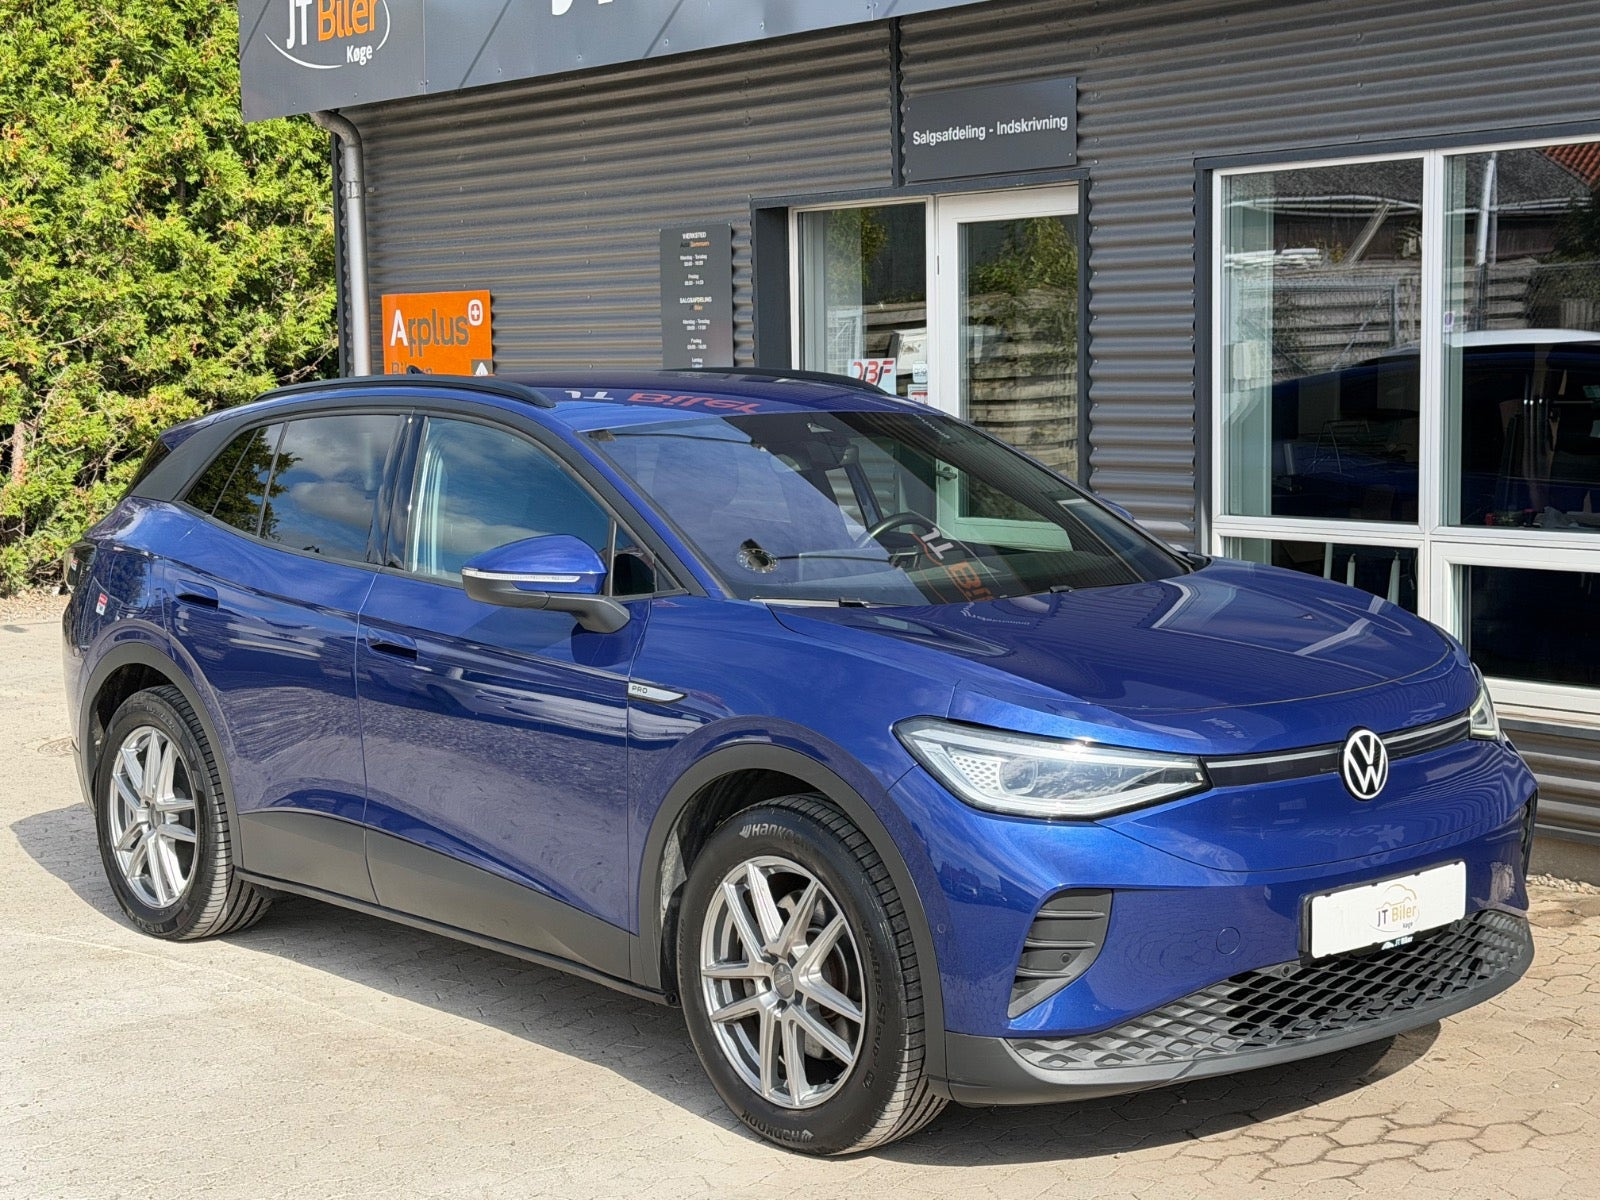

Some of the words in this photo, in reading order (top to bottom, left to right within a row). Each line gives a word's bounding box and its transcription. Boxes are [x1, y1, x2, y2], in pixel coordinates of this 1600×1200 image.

[286, 0, 313, 49] JT
[317, 0, 379, 42] Biler
[346, 45, 373, 66] Køge
[912, 125, 986, 146] Salgsafdeling
[996, 114, 1068, 136] Indskrivning
[631, 685, 648, 694] PRO
[1391, 904, 1416, 922] Biler
